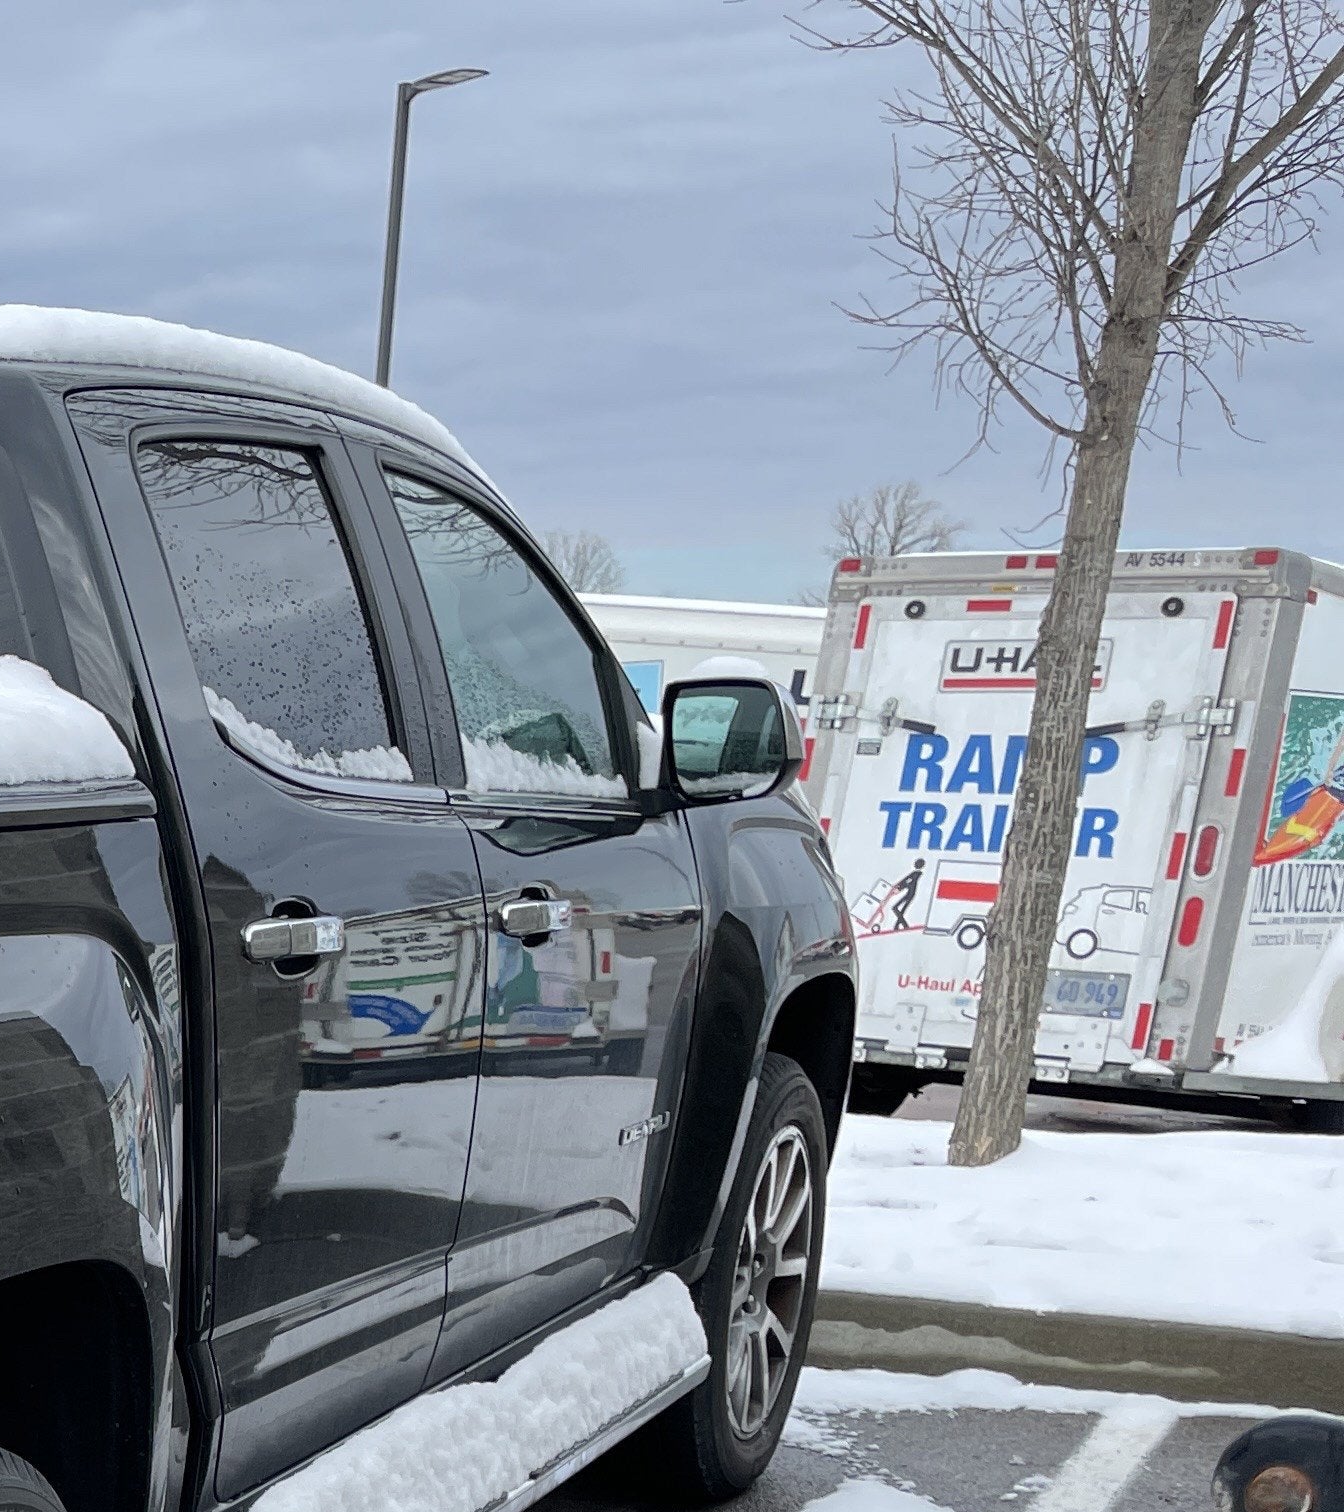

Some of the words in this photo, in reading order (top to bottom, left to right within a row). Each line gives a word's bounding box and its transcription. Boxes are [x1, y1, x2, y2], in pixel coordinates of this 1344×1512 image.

[1124, 552, 1144, 567] AV
[1149, 552, 1186, 567] 5544
[879, 800, 1119, 859] TRAIR
[897, 974, 956, 993] U-Haul
